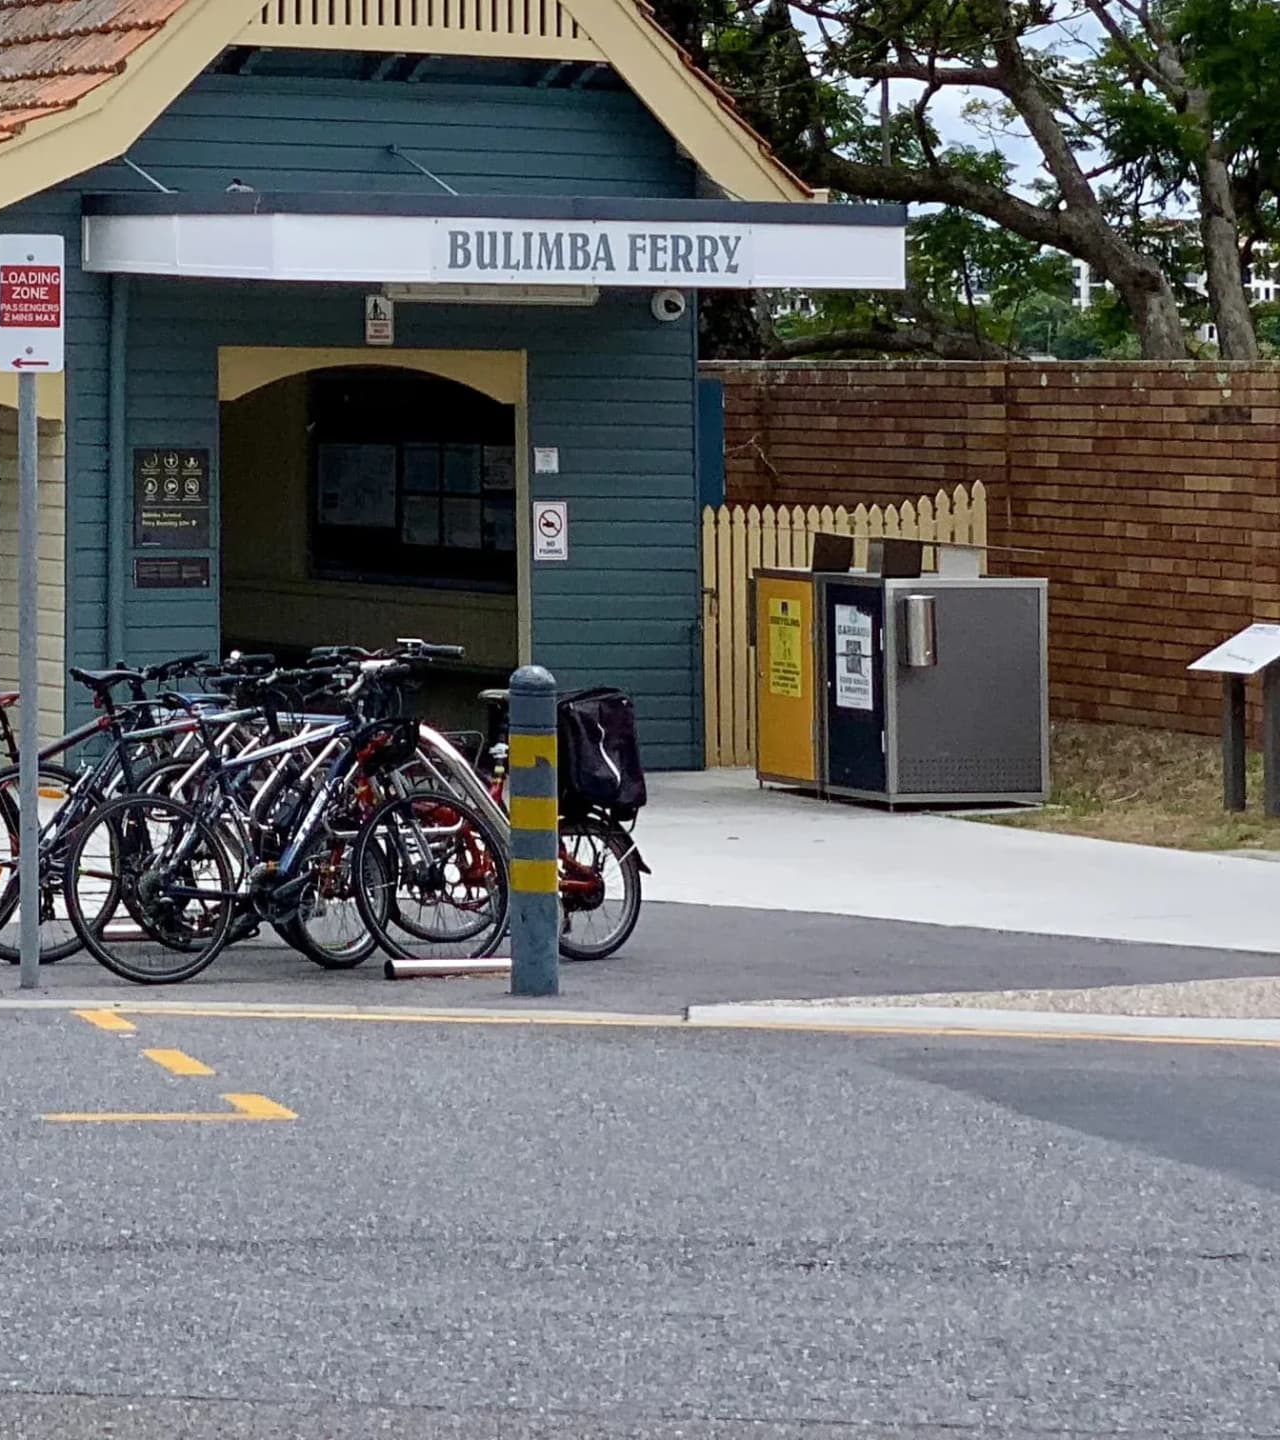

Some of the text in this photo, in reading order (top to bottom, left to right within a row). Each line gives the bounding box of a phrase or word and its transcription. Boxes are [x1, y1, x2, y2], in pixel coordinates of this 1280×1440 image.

[447, 230, 742, 274] BULIMBA FERRY
[0, 272, 60, 284] LOADING
[11, 287, 50, 300] ZONE
[0, 303, 60, 312] PASSENGERS
[3, 313, 57, 322] 2 MINS MAX
